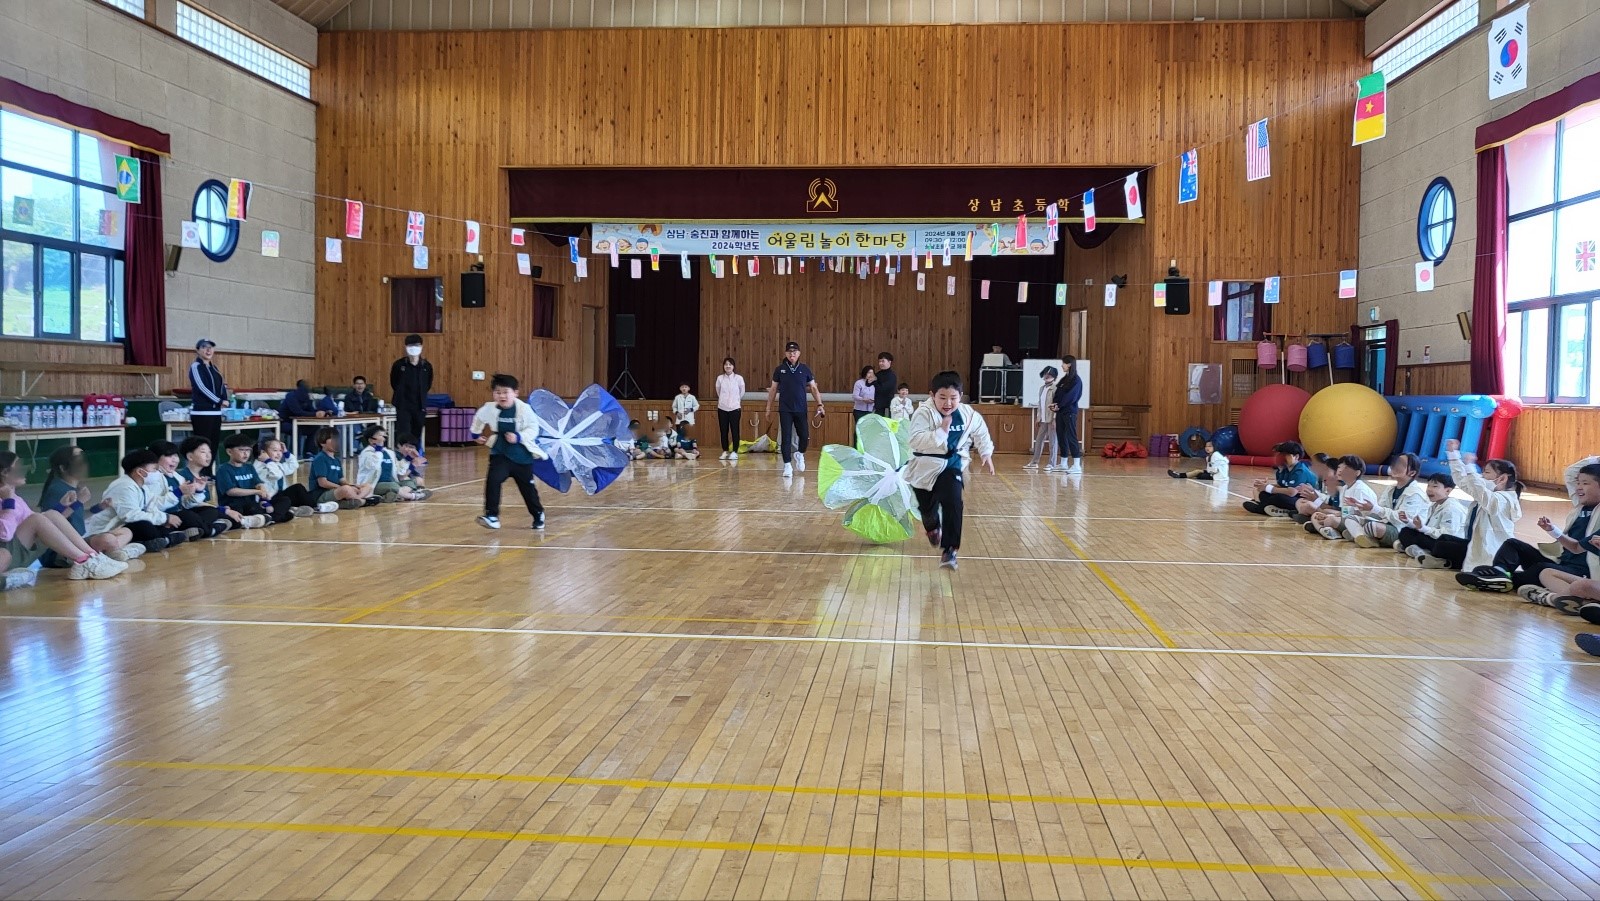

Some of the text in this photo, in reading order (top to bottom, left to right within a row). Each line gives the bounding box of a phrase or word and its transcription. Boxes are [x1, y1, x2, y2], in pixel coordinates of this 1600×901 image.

[721, 229, 760, 239] 함께하는
[711, 241, 760, 250] 2024학년도
[767, 232, 907, 249] 어울림 놀이 한마당
